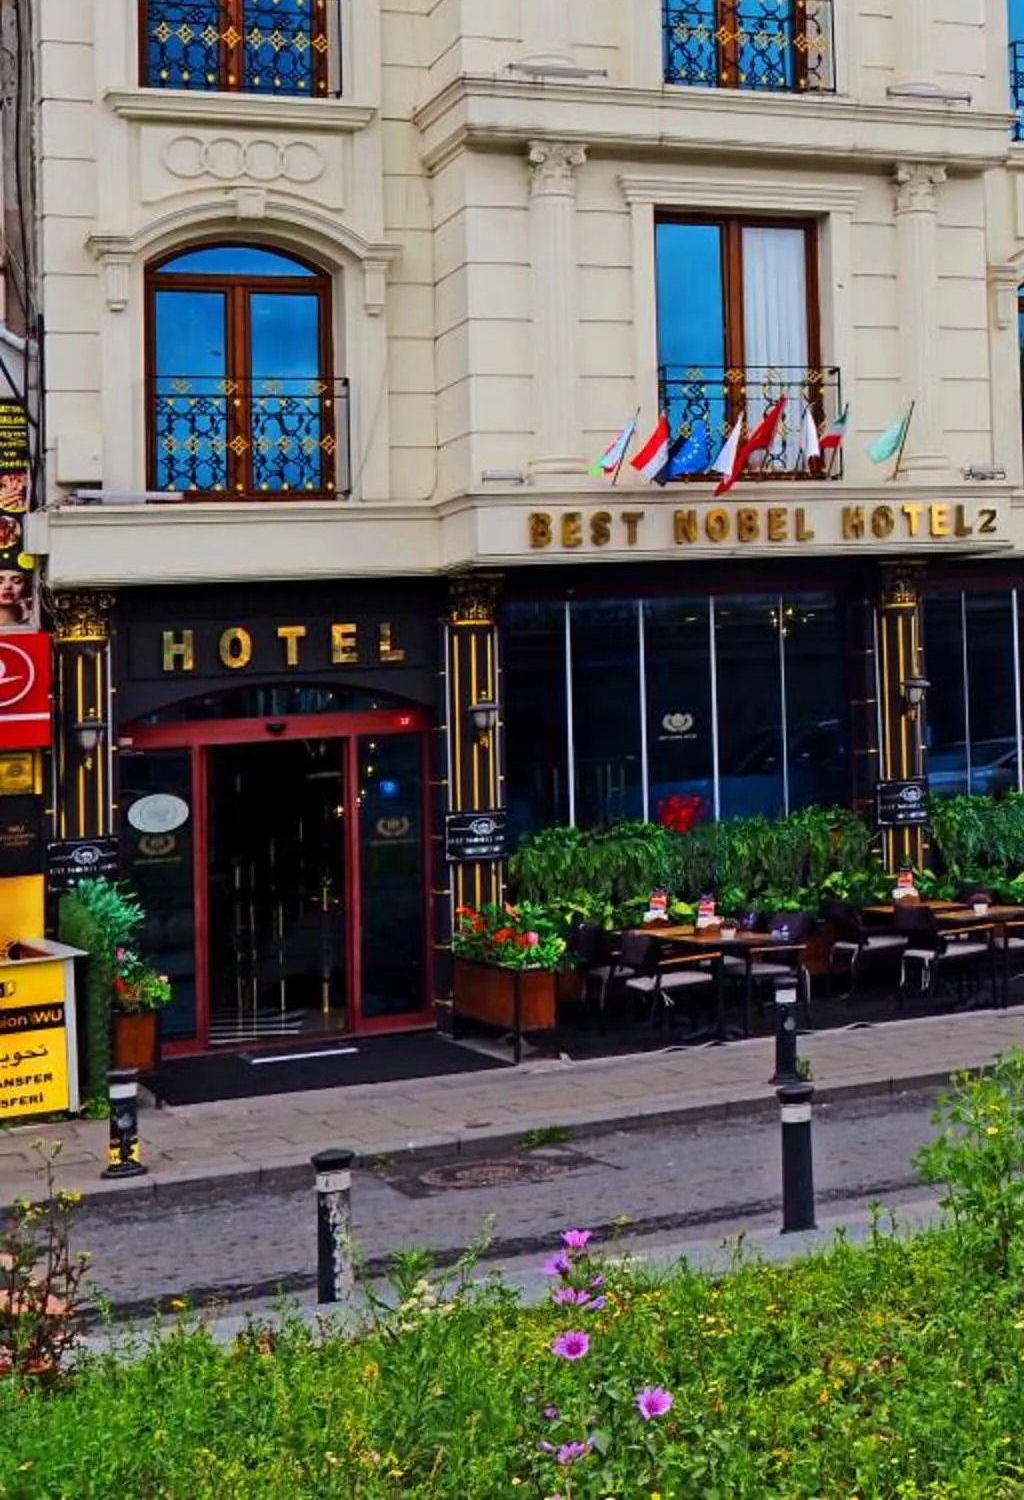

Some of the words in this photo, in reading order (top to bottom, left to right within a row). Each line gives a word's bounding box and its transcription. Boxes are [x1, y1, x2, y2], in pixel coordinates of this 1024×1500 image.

[529, 511, 645, 548] BEST
[673, 507, 814, 544] NOBEL
[162, 622, 406, 672] HOTEL
